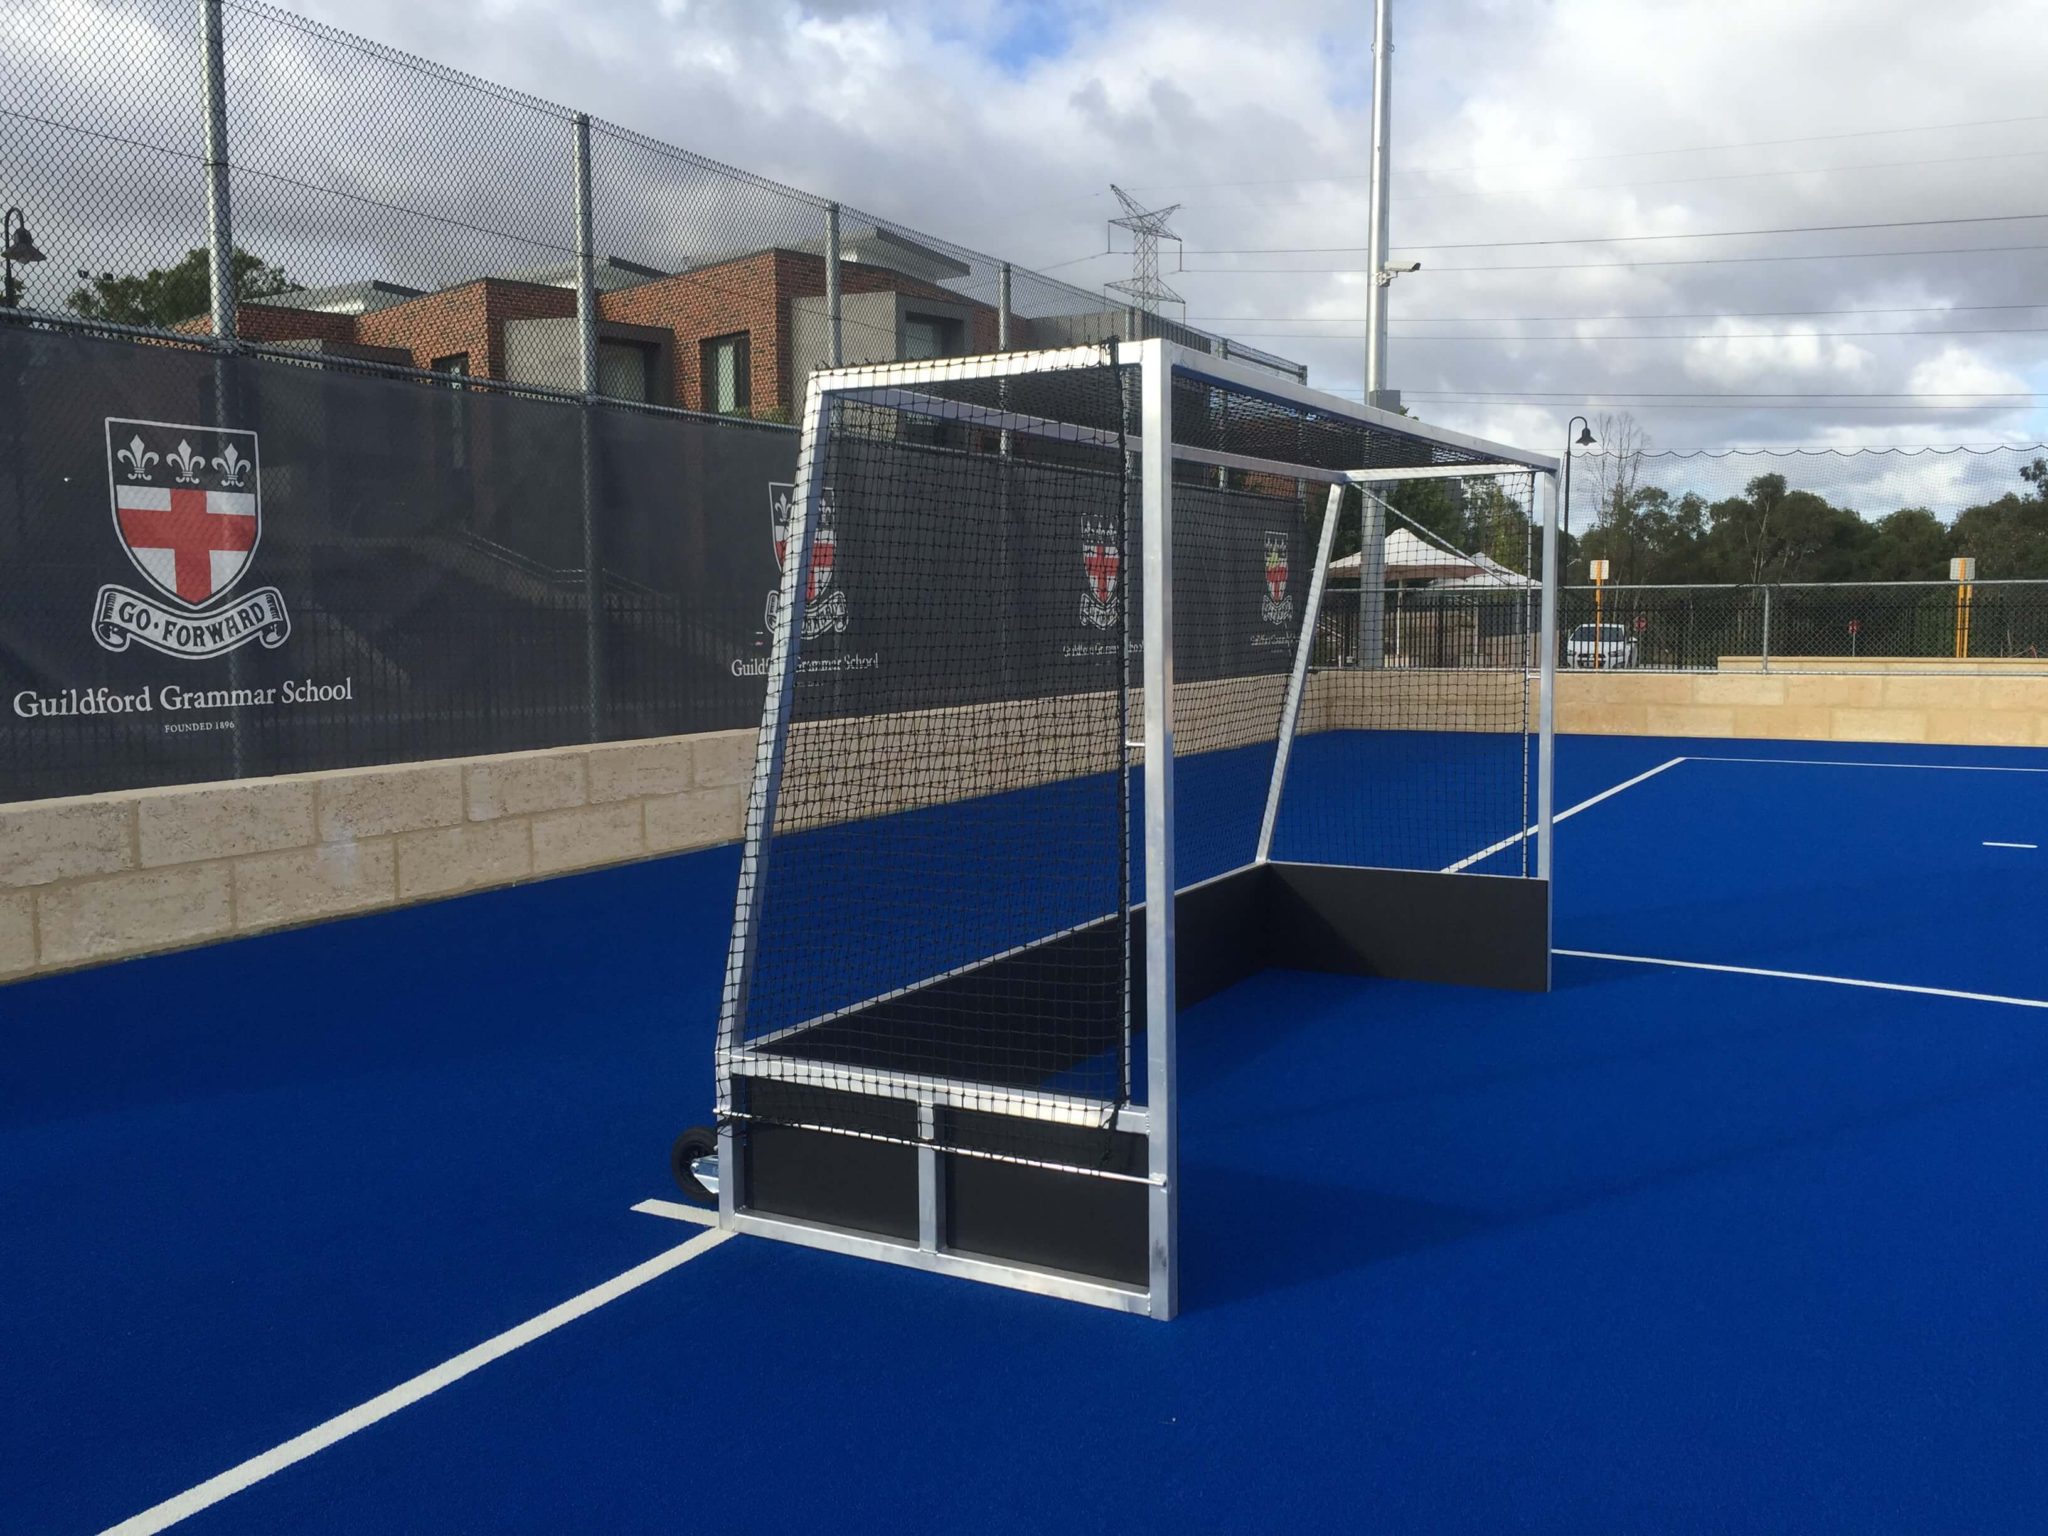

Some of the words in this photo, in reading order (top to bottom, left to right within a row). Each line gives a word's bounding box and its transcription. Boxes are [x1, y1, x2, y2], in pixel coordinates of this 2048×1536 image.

[161, 602, 266, 648] FORWARD
[731, 657, 771, 677] Guildf
[13, 686, 153, 718] Guildford
[159, 685, 277, 711] Grammar
[281, 677, 353, 704] School
[164, 722, 213, 733] FOUNDED
[215, 721, 235, 730] 1896
